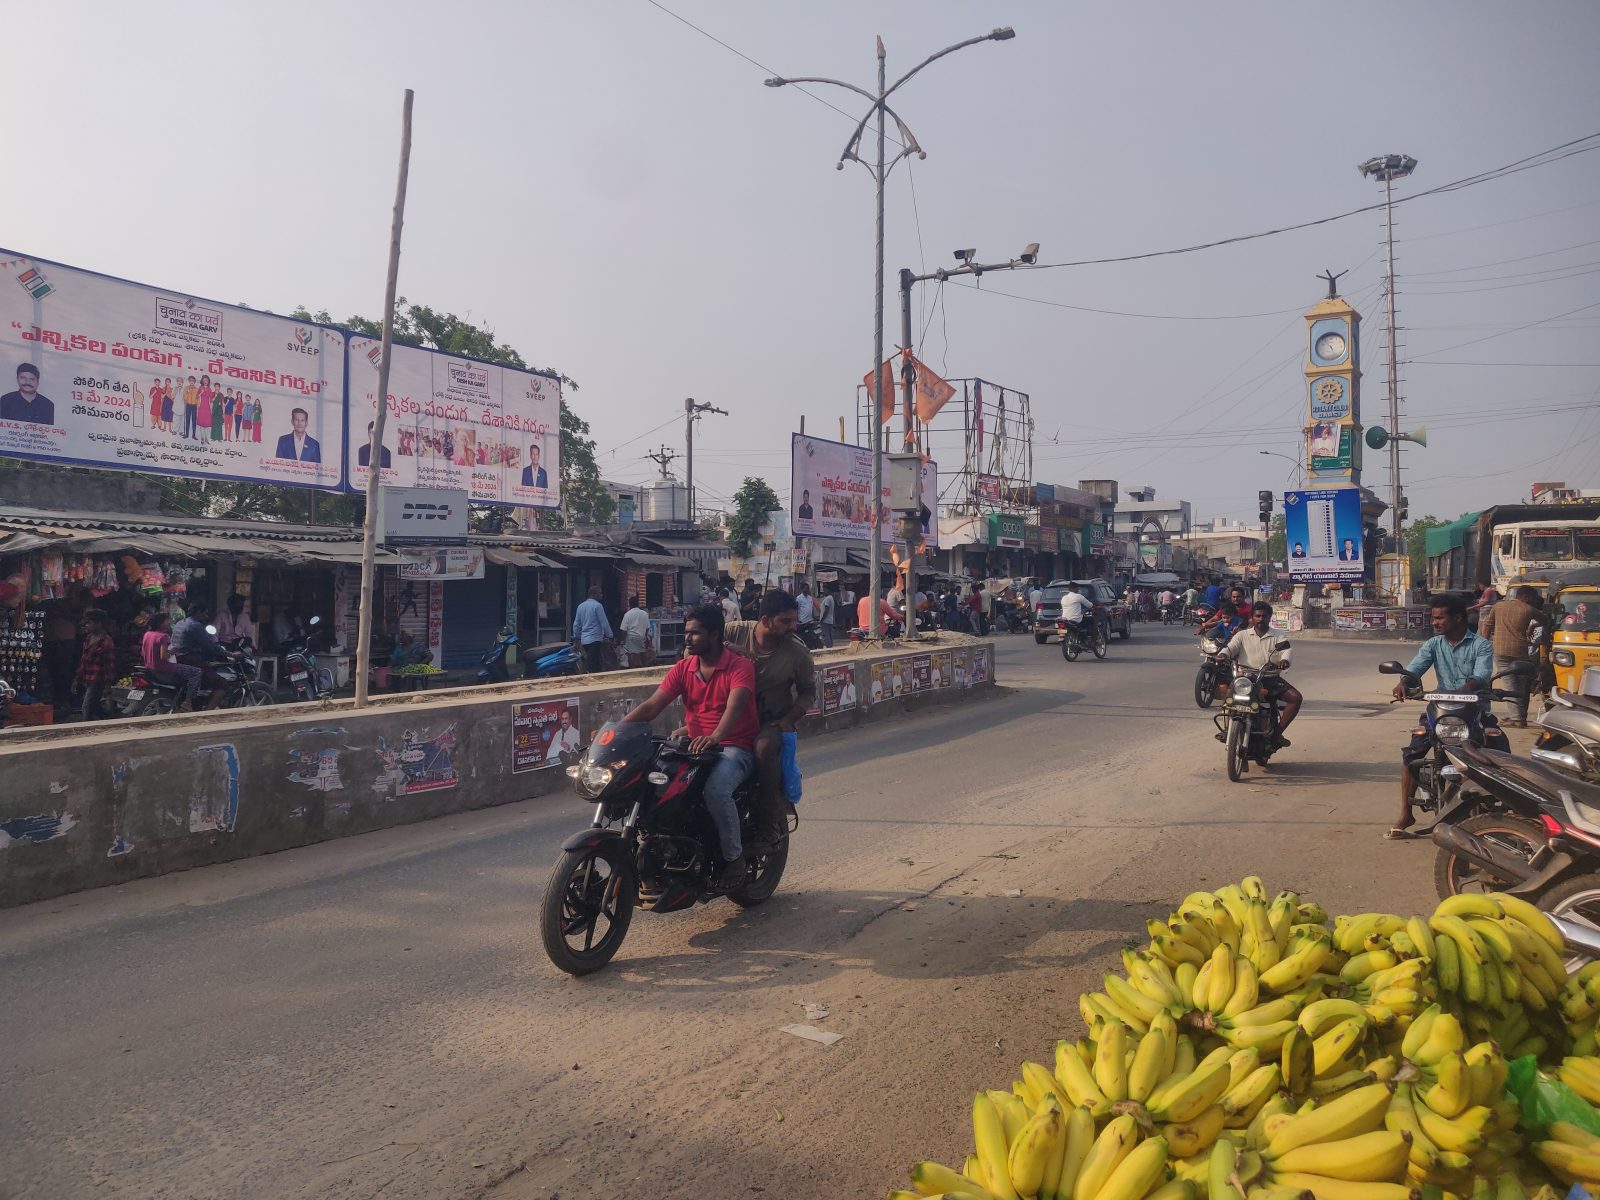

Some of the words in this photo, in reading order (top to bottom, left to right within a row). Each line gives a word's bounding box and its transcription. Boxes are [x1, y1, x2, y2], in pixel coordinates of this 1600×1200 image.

[160, 305, 186, 318] चुनाव
[189, 311, 203, 322] का
[205, 314, 219, 327] पर्व
[170, 317, 188, 328] DESH
[188, 321, 198, 330] KA
[199, 323, 218, 333] GARV
[287, 342, 320, 356] SVEEP
[112, 342, 182, 368] పండుగ
[208, 358, 277, 385] దేశానికి
[73, 377, 110, 391] పోలింగ్
[112, 381, 130, 394] తేది
[71, 390, 83, 401] 13
[86, 389, 101, 403] మే
[104, 396, 131, 408] 2024
[526, 391, 546, 401] SVEEP
[71, 404, 130, 422] సోమవారం
[425, 401, 468, 422] పండుగ
[482, 408, 520, 431] దేశానికి
